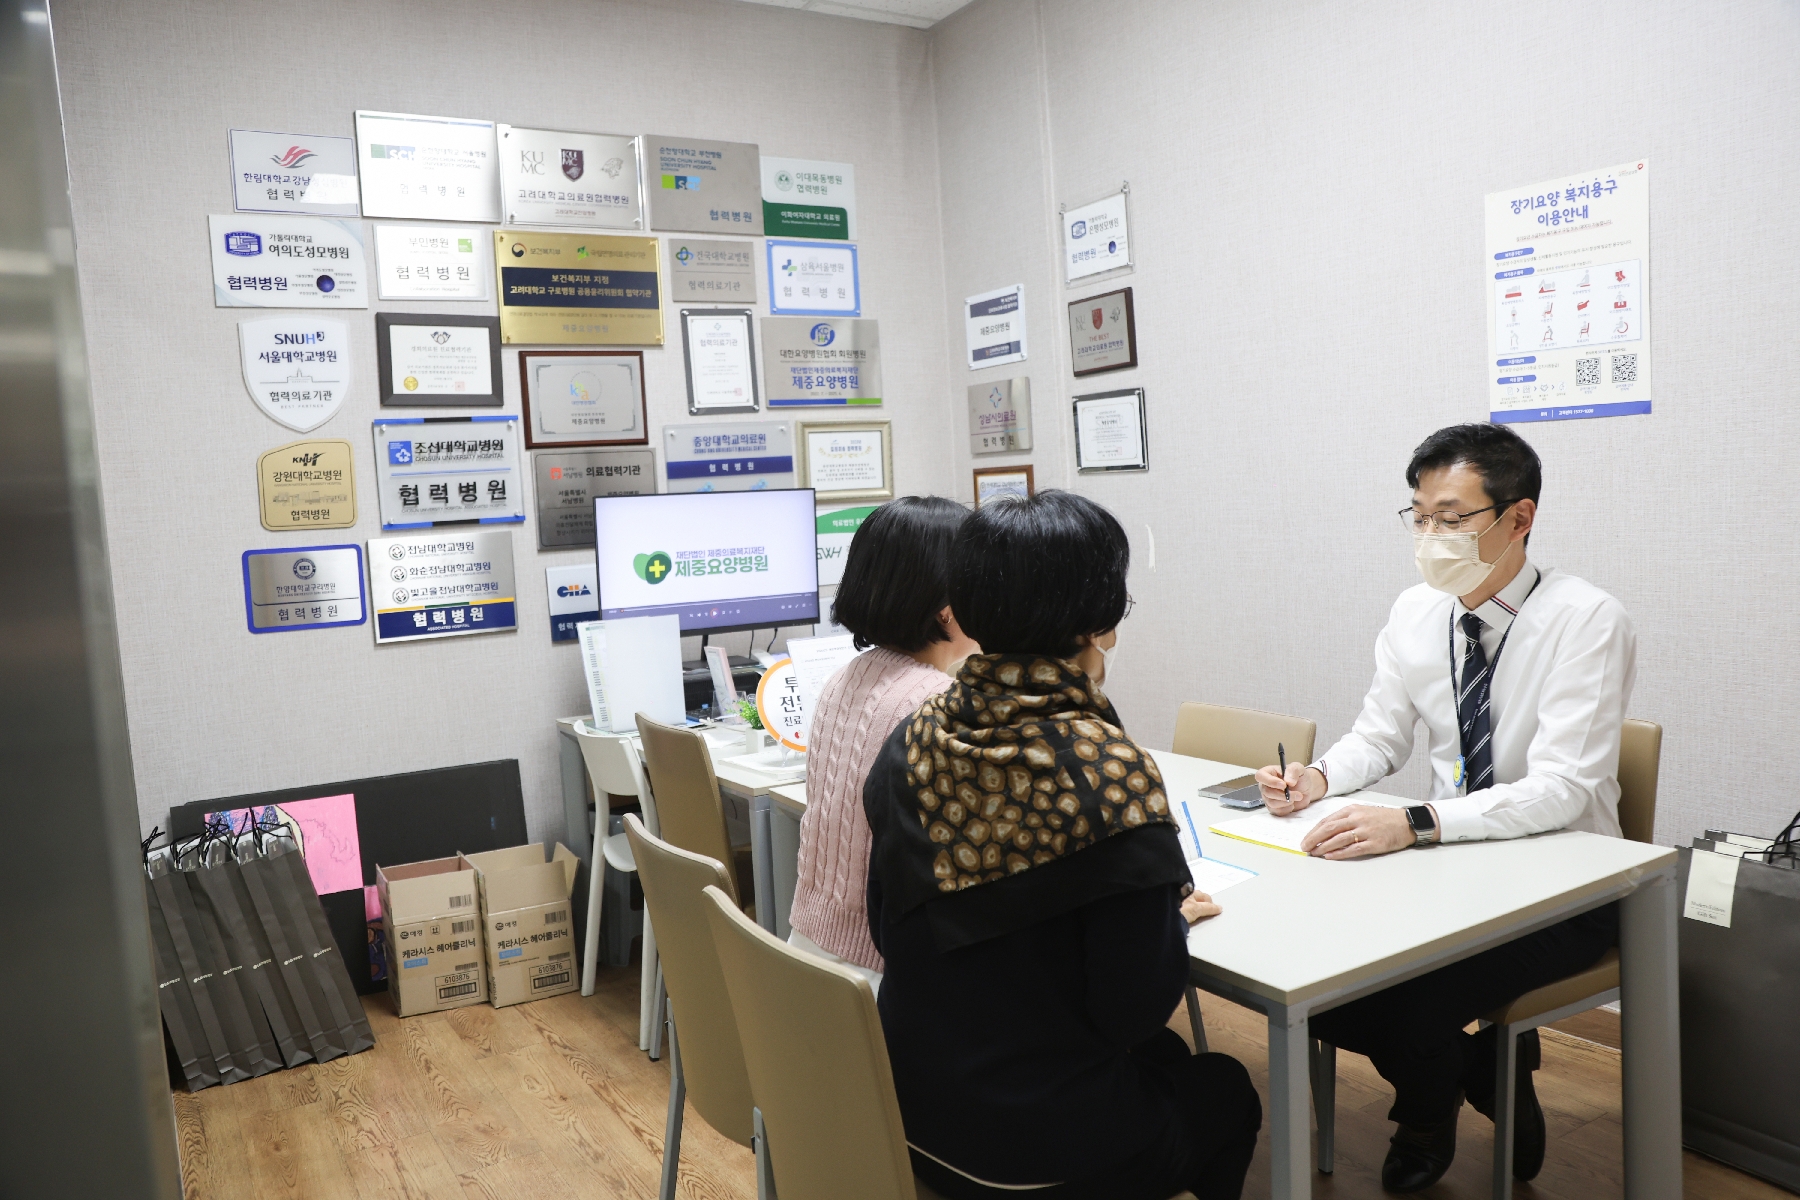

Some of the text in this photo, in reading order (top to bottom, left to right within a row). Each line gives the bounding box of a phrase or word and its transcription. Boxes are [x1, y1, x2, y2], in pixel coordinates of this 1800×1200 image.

[521, 150, 544, 163] KU
[521, 162, 545, 175] MC
[796, 172, 842, 186] 이대목동병원
[518, 189, 629, 205] 고려대학교의료원협력병원
[796, 184, 828, 196] 협력병원
[1510, 178, 1618, 215] 장기요양 복지용구
[710, 209, 752, 223] 협력병원
[1537, 204, 1589, 226] 이용안내
[269, 233, 313, 243] 가톨릭대학교
[269, 244, 349, 259] 여의도성모병원
[696, 250, 749, 263] 건국대학교병원
[1071, 247, 1097, 264] 협력병원
[396, 266, 470, 281] 협력병원
[801, 262, 845, 274] 삼육서울병원
[227, 276, 288, 291] 협력병원
[551, 274, 609, 285] 보건복지부 지정
[689, 279, 741, 291] 협력의료기관
[510, 286, 546, 297] 고려대학교
[548, 287, 576, 296] 구로병원
[783, 285, 847, 299] 협력병원
[980, 321, 1011, 336] 제중요양병원
[274, 333, 316, 345] SNUH
[259, 350, 338, 363] 서울대학교병원
[780, 349, 867, 359] 대한요양병원협회 회원병원
[792, 375, 859, 390] 제중요양병원
[269, 390, 332, 403] 협력의료기관
[415, 439, 504, 454] 조선대학교병원
[694, 433, 767, 448] 중앙대학교의료원
[415, 451, 504, 462] CHOSUN UNIVERSITY HOSPITAL
[586, 465, 642, 477] 의료협력기관
[709, 461, 755, 473] 협력병원
[273, 470, 342, 483] 강원대학교병원
[399, 480, 507, 506] 협력병원
[559, 489, 587, 497] 서울특별시
[562, 497, 585, 505] 서남병원
[291, 509, 330, 521] 협력병원
[408, 541, 475, 556] 전남대학교병원
[675, 546, 765, 560] 재단법인 제중의료복지재단
[409, 561, 492, 576] 화순전남대학교병원
[674, 555, 769, 577] 제중요양병원
[276, 582, 337, 594] 한양대학교구리병원
[410, 582, 499, 597] 빛고을전남대학교병원
[277, 604, 338, 621] 협력병원
[412, 607, 485, 628] 협력병원
[498, 929, 569, 949] 케라시스 헤어클리닉
[402, 938, 477, 959] 케라시스 헤어클리닉
[538, 962, 563, 974] 6103876
[444, 973, 470, 984] 6103876
